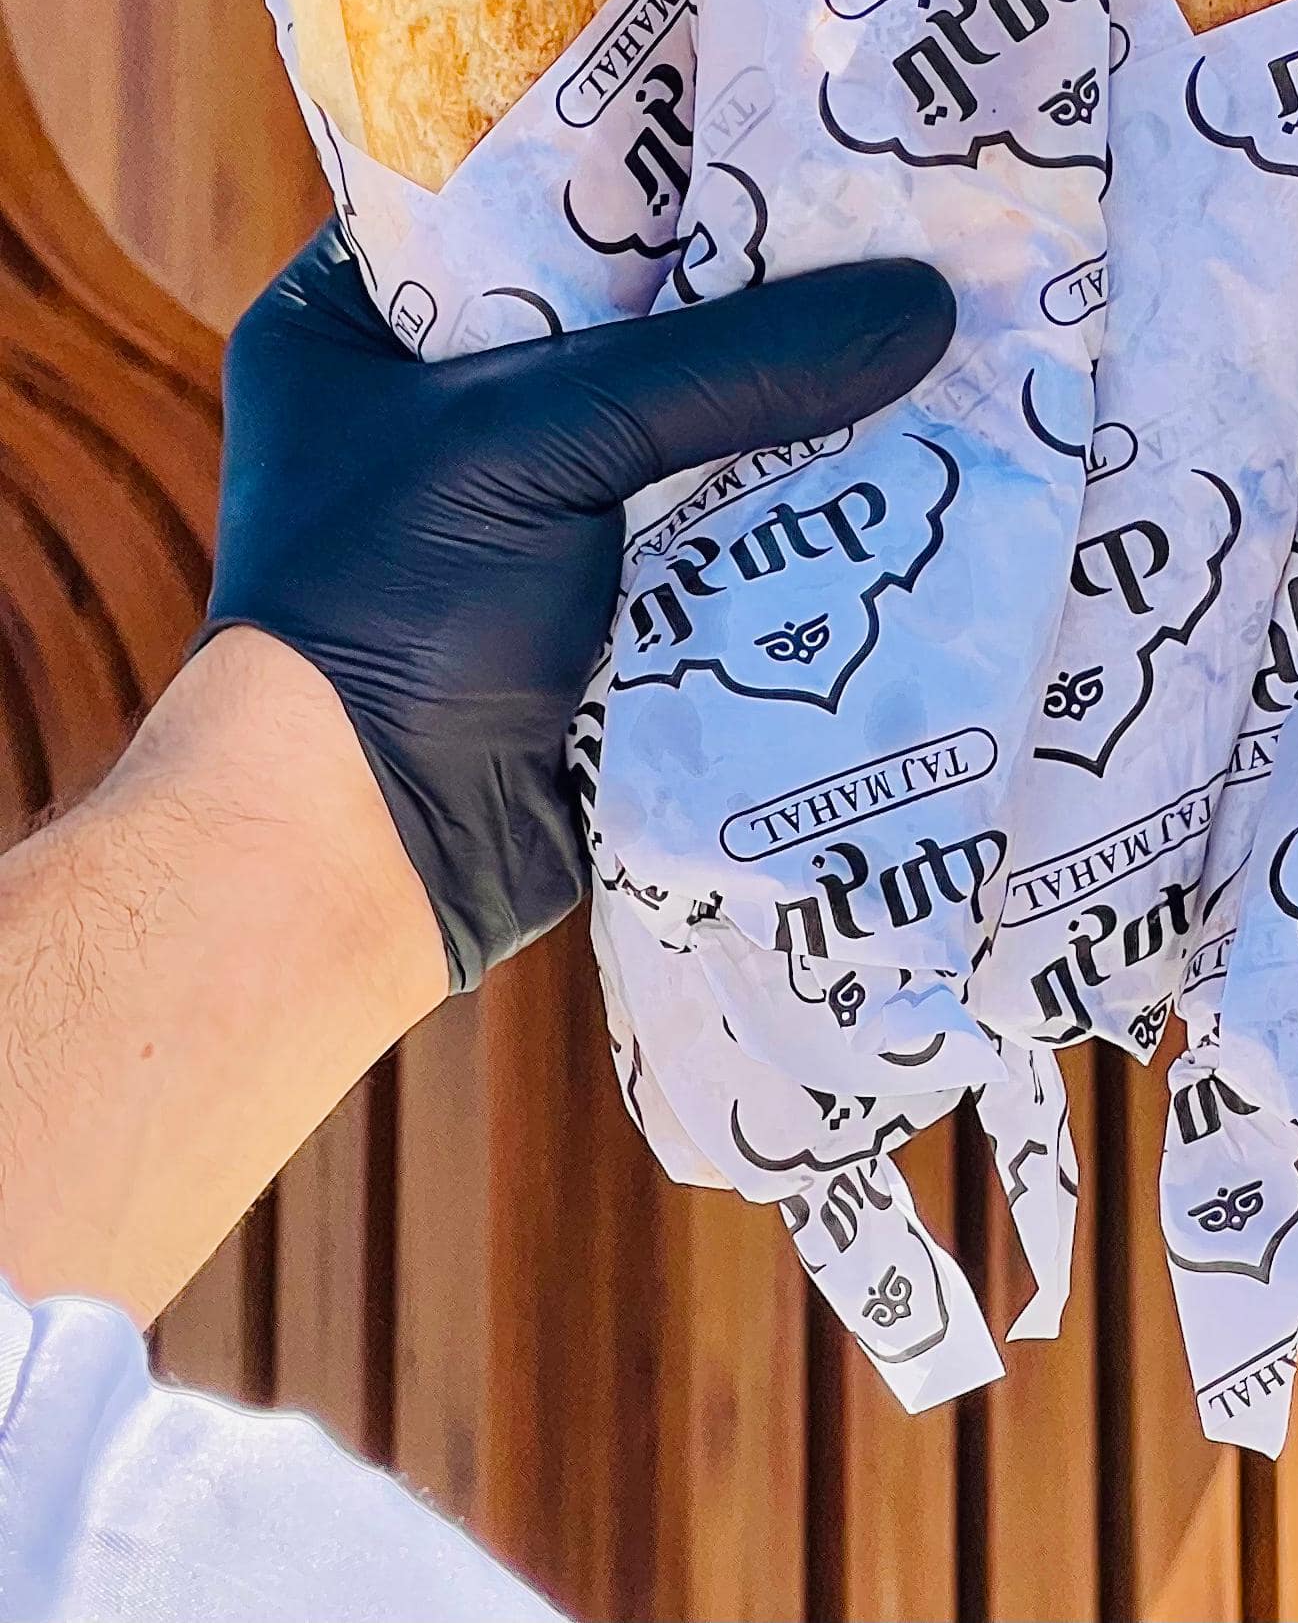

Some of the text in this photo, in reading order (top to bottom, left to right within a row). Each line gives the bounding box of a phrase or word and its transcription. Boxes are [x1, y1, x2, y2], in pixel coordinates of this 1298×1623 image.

[750, 745, 968, 844] TAJ MAHAL
[1012, 829, 1152, 911] MAHAL
